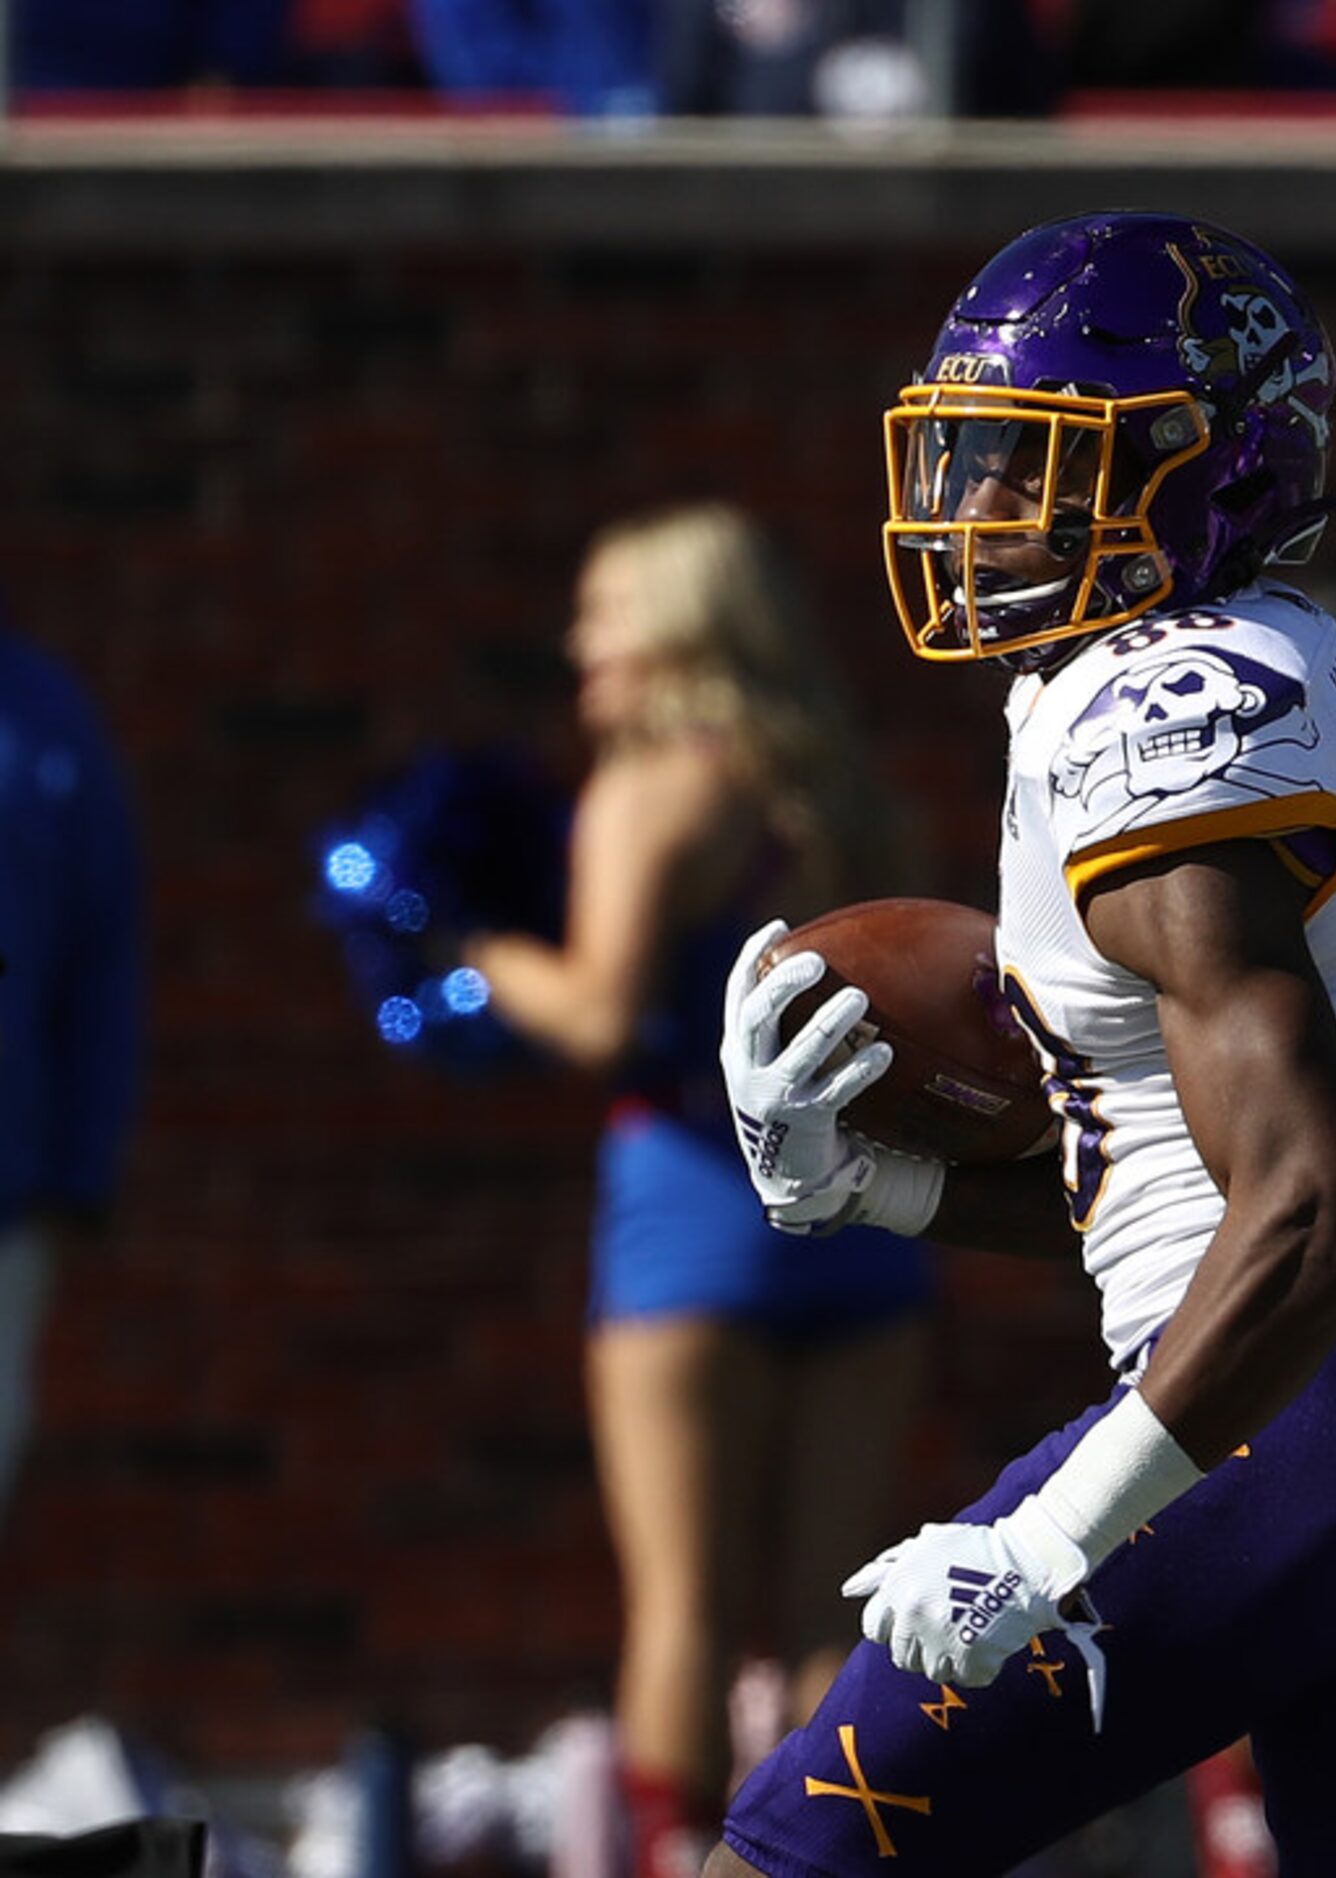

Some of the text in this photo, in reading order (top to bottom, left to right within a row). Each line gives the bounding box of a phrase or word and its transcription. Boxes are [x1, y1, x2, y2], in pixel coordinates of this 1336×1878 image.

[936, 356, 984, 384] ECU
[1105, 609, 1236, 656] 88
[759, 1120, 790, 1179] adidas
[959, 1570, 1022, 1645] adidas
